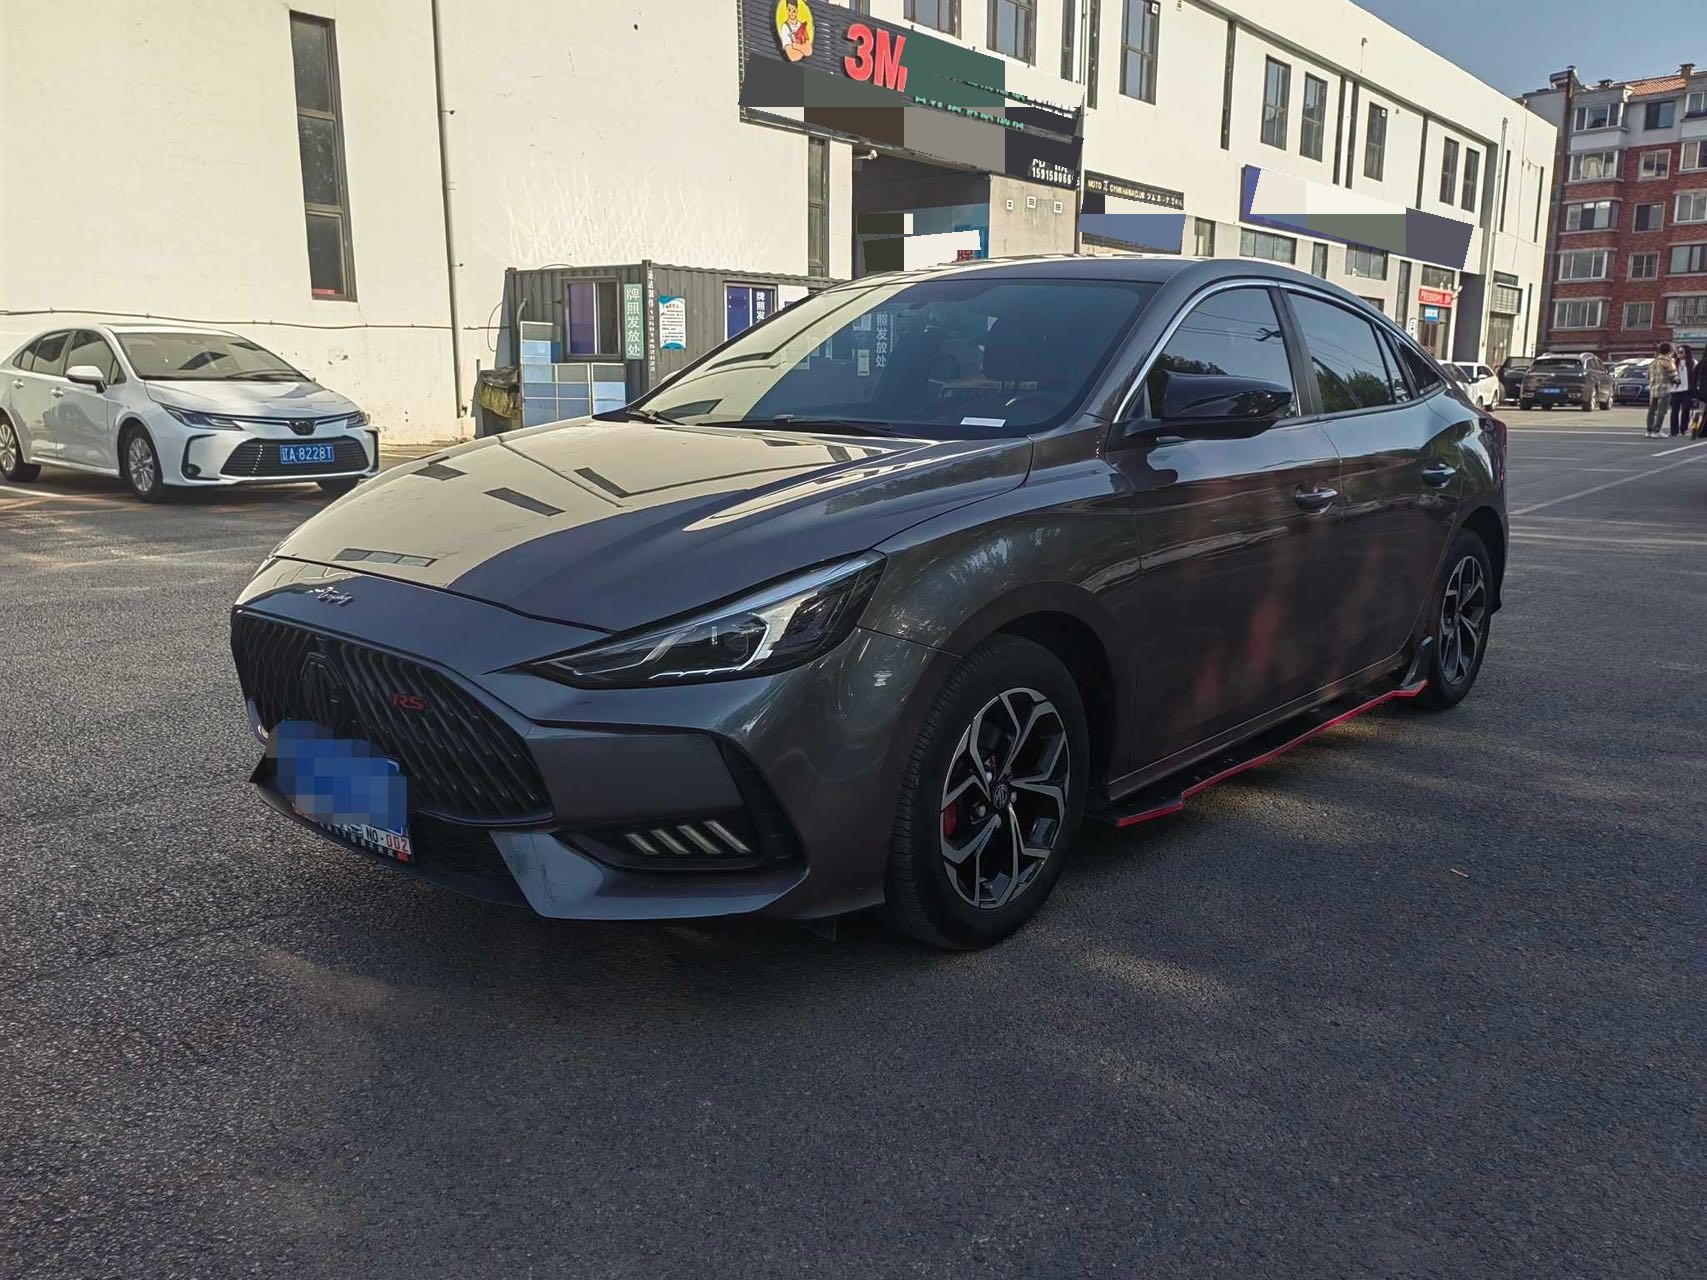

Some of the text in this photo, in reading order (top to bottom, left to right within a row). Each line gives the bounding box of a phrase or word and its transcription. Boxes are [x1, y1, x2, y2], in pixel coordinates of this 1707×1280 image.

[626, 287, 641, 357] 牌照发放处
[756, 291, 766, 323] 牌照发
[875, 310, 888, 368] 照发放处
[391, 691, 427, 711] RS
